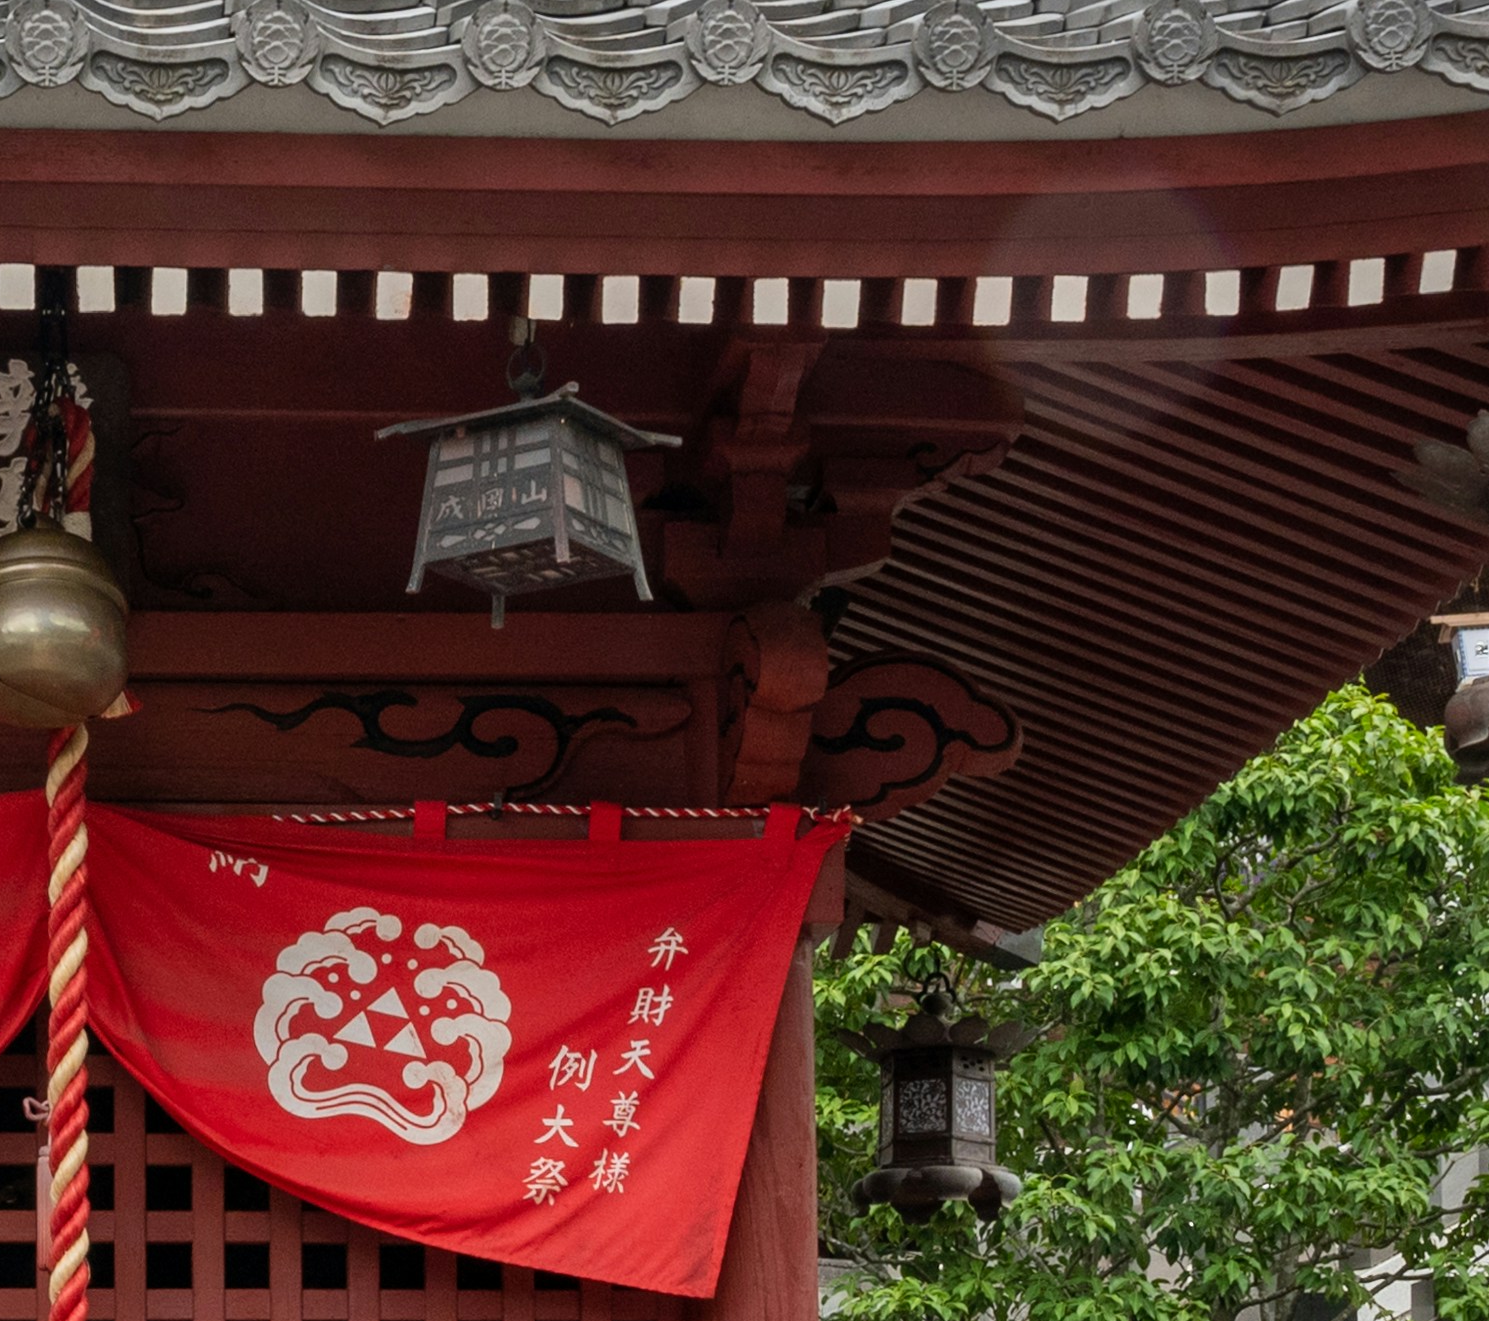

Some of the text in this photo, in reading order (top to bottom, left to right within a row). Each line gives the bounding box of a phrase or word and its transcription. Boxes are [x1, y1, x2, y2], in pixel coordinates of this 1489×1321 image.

[522, 1045, 598, 1206] 例大祭
[590, 927, 689, 1194] 弁財天尊様
